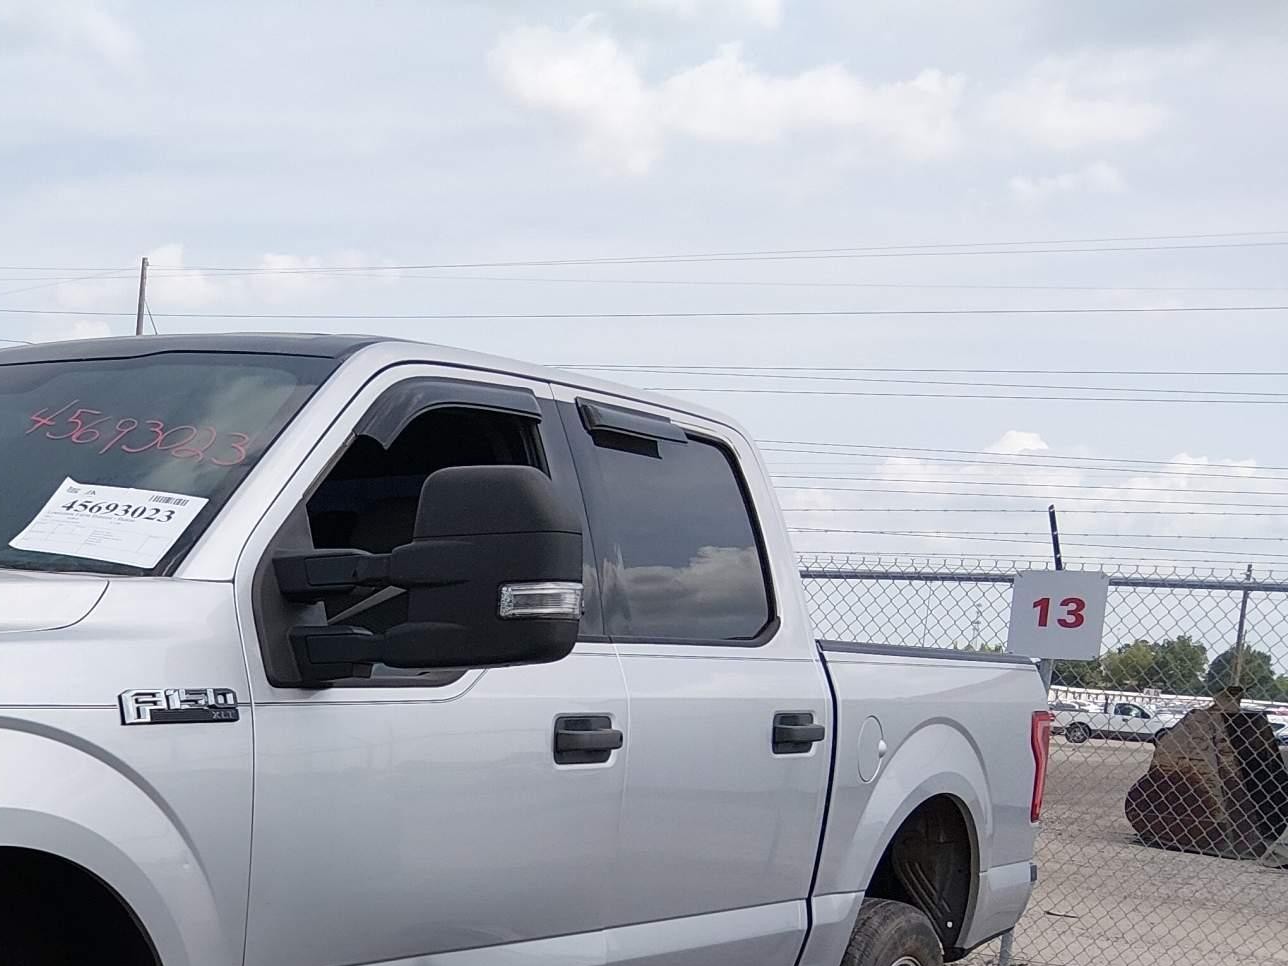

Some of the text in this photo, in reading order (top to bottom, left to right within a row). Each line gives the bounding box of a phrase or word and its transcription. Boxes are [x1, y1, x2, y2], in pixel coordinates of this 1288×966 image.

[25, 400, 250, 466] 45693023
[60, 499, 176, 523] 45693023
[1032, 597, 1086, 629] 13
[212, 711, 235, 720] XLT
